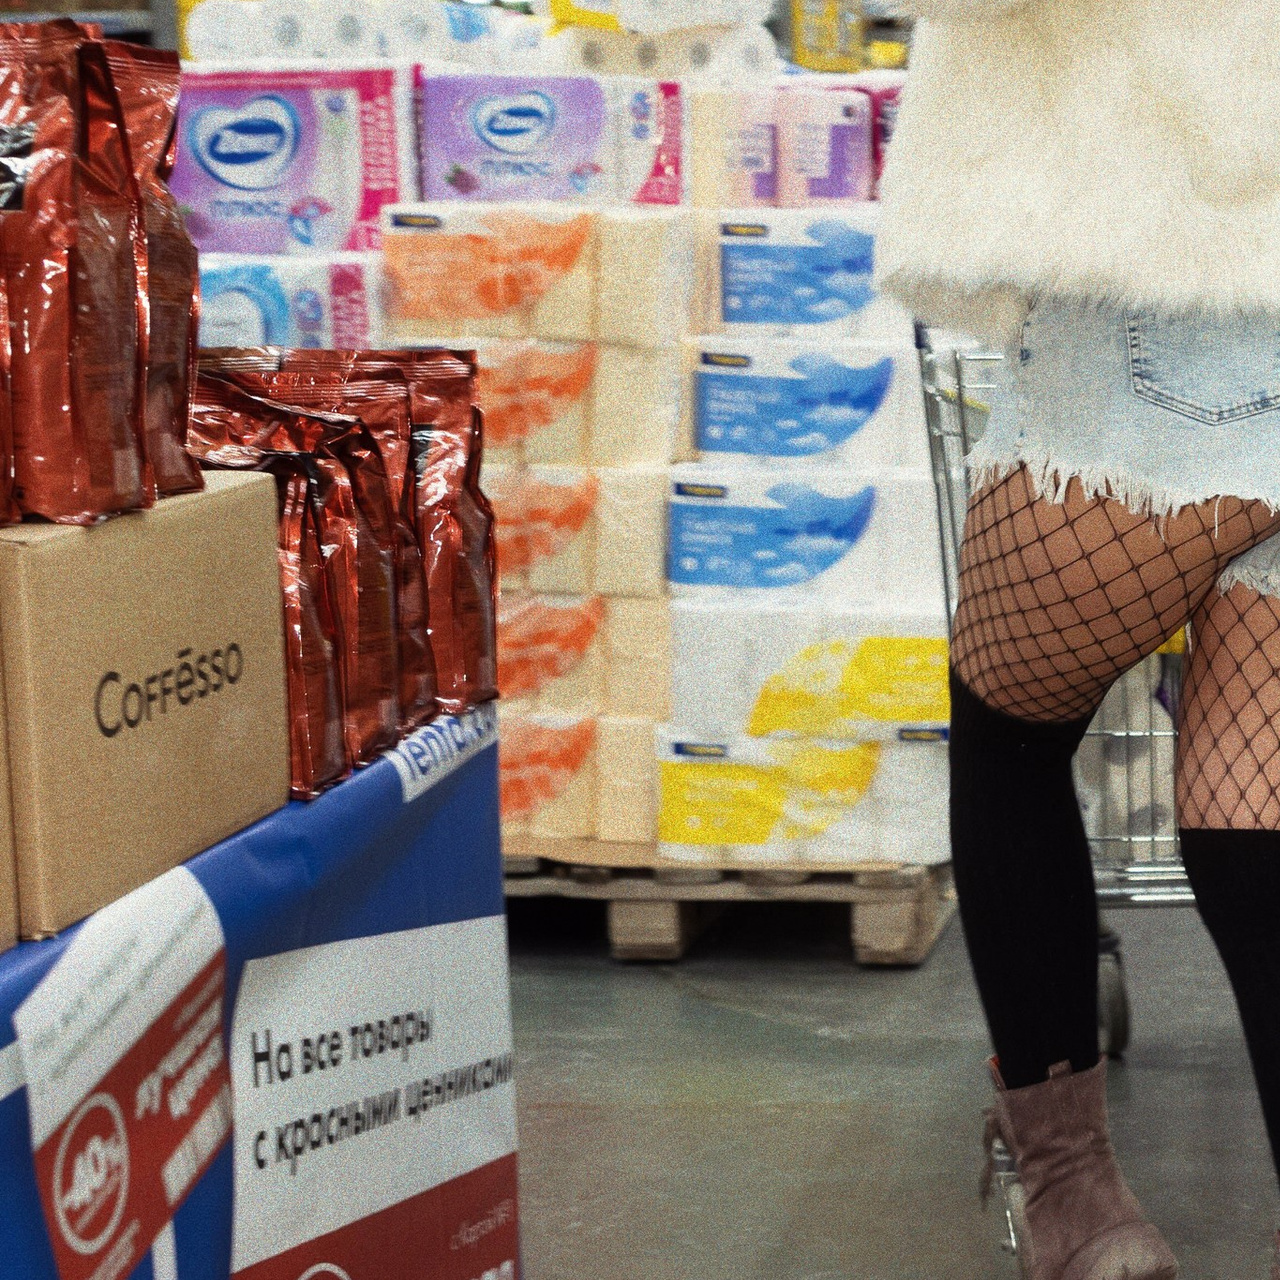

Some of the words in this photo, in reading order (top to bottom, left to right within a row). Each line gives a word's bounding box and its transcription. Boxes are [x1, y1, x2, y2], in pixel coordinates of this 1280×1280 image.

[250, 1029, 294, 1087] На
[301, 1030, 342, 1074] все
[348, 1009, 434, 1062] товары
[253, 1130, 268, 1170] с
[275, 1088, 401, 1176] красными
